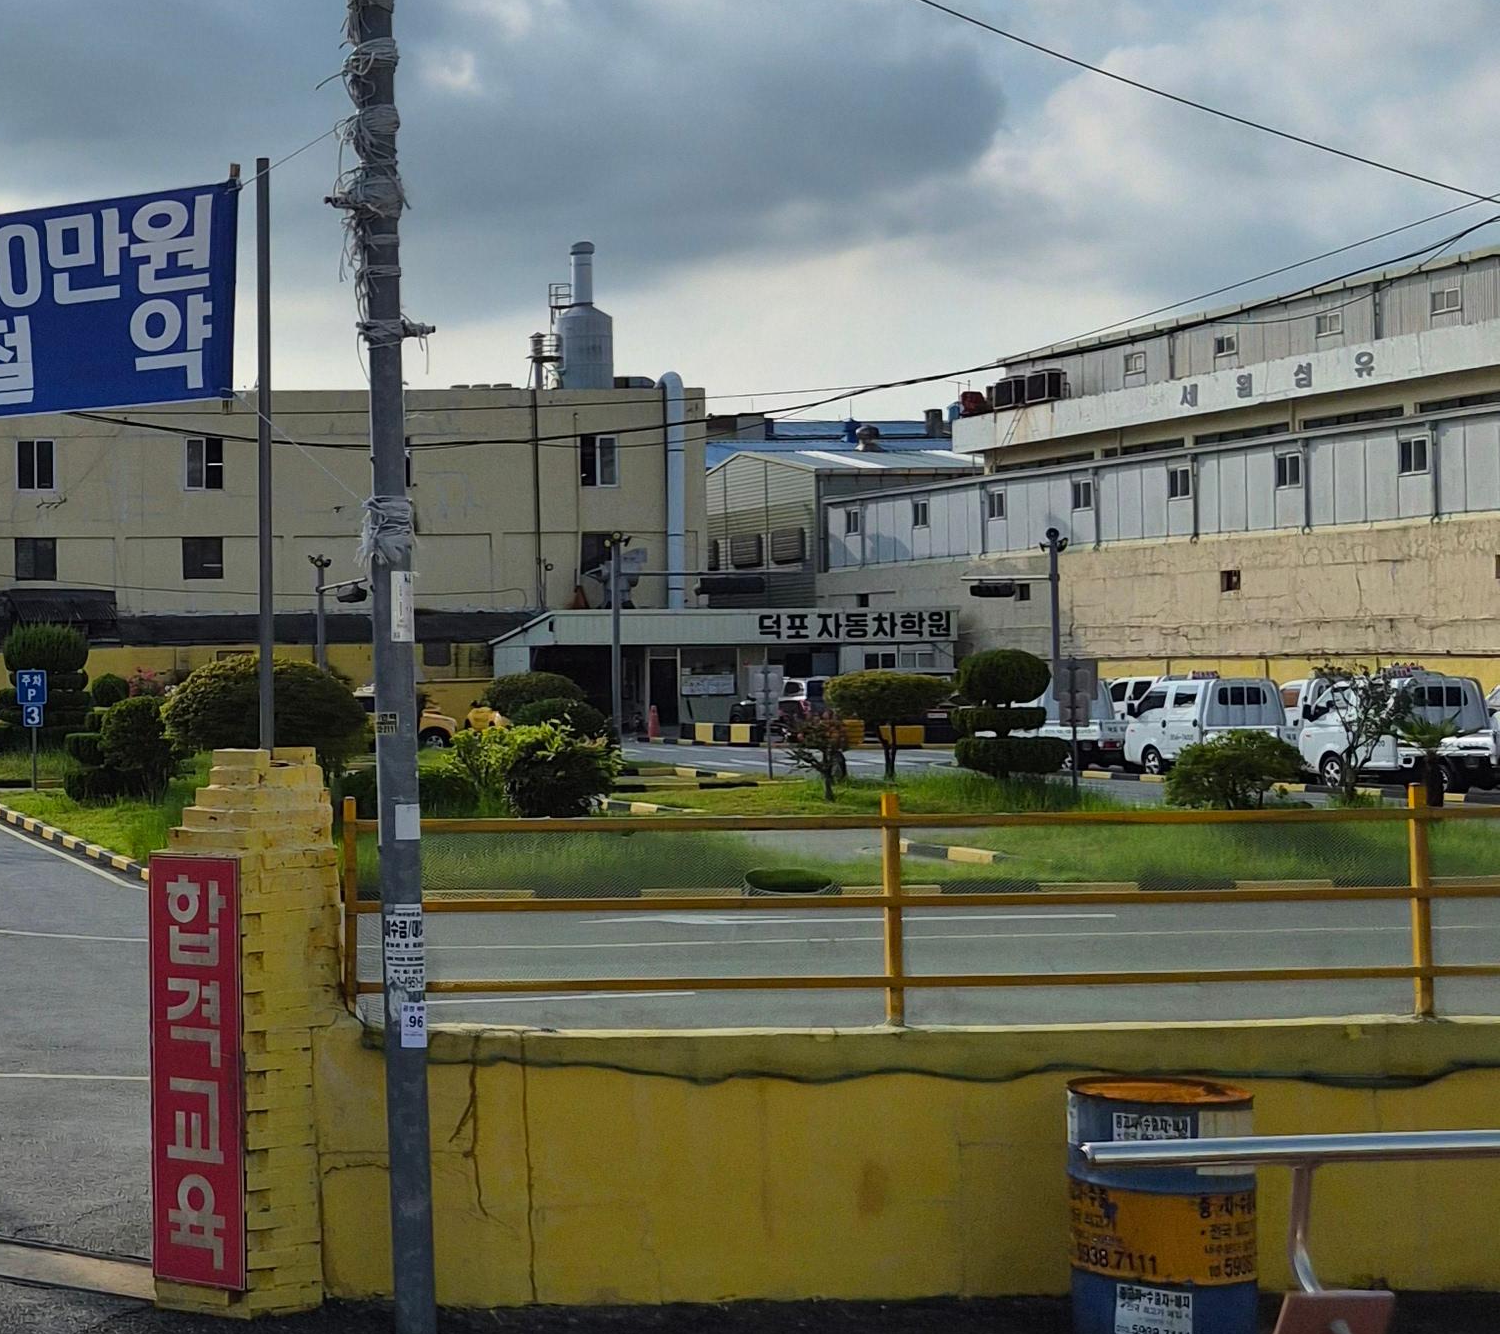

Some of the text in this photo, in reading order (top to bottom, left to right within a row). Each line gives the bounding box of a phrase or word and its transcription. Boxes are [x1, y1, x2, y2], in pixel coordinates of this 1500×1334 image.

[758, 609, 952, 640] 덕포 자동차학원
[21, 674, 42, 687] 주차
[27, 688, 37, 701] P
[26, 706, 40, 725] 3
[165, 874, 227, 1271] 합격교육
